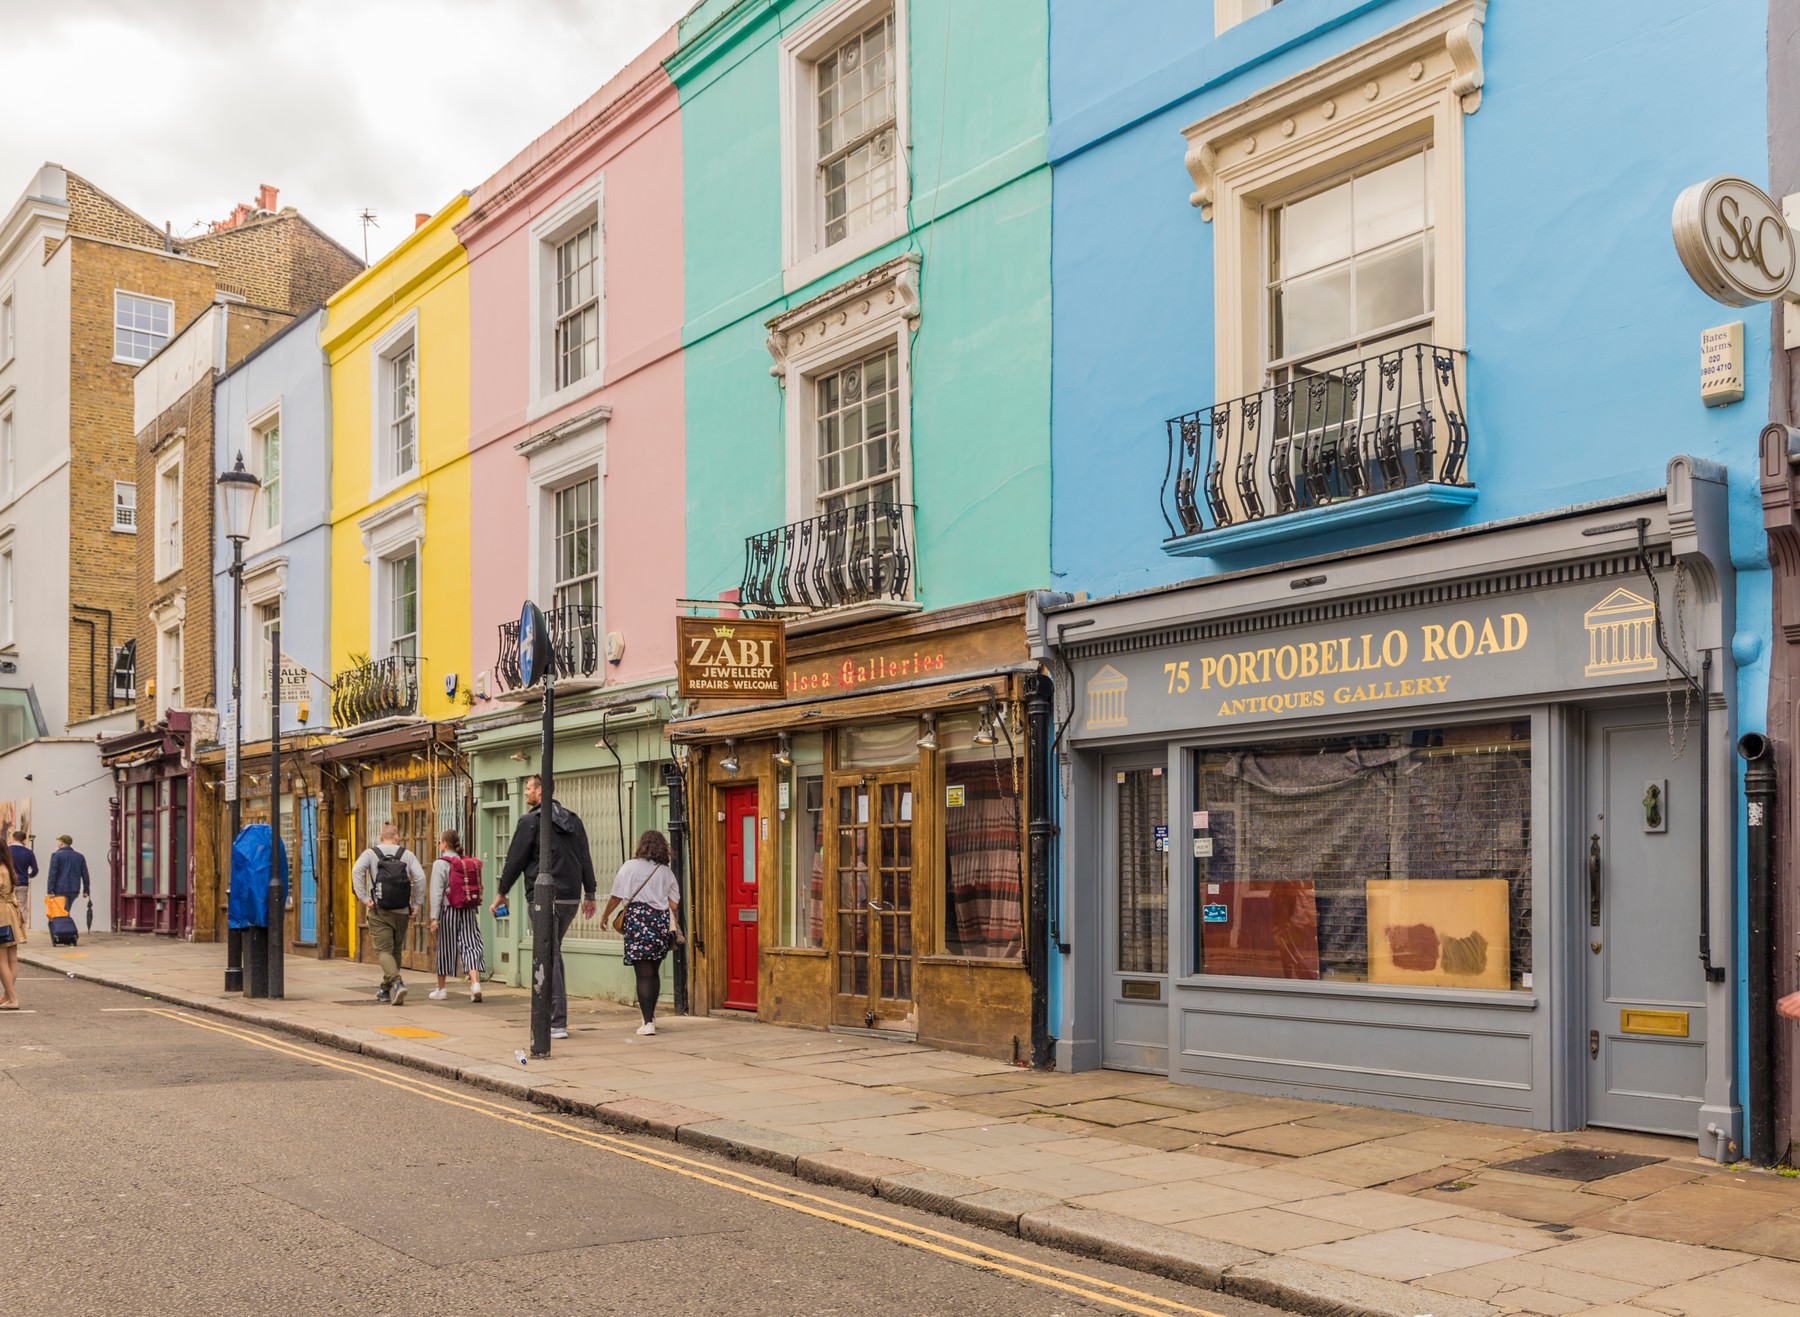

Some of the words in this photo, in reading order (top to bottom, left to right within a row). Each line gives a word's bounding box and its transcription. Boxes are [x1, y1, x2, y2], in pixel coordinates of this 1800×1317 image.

[1717, 196, 1785, 281] S&C
[1703, 332, 1727, 344] Bates
[1709, 354, 1720, 363] 020
[689, 638, 774, 667] ZABI
[1164, 661, 1190, 694] 75
[1200, 630, 1408, 689] PORTOBELLO
[1422, 613, 1529, 663] ROAD
[268, 668, 307, 677] SALLS
[702, 667, 773, 679] JEWELLERY
[841, 652, 944, 686] Galleries
[287, 676, 307, 684] LET
[689, 680, 729, 689] REPAIRS
[733, 680, 778, 690] WELCOME
[1217, 690, 1325, 717] ANTIQUES
[1333, 675, 1452, 704] GALLERY
